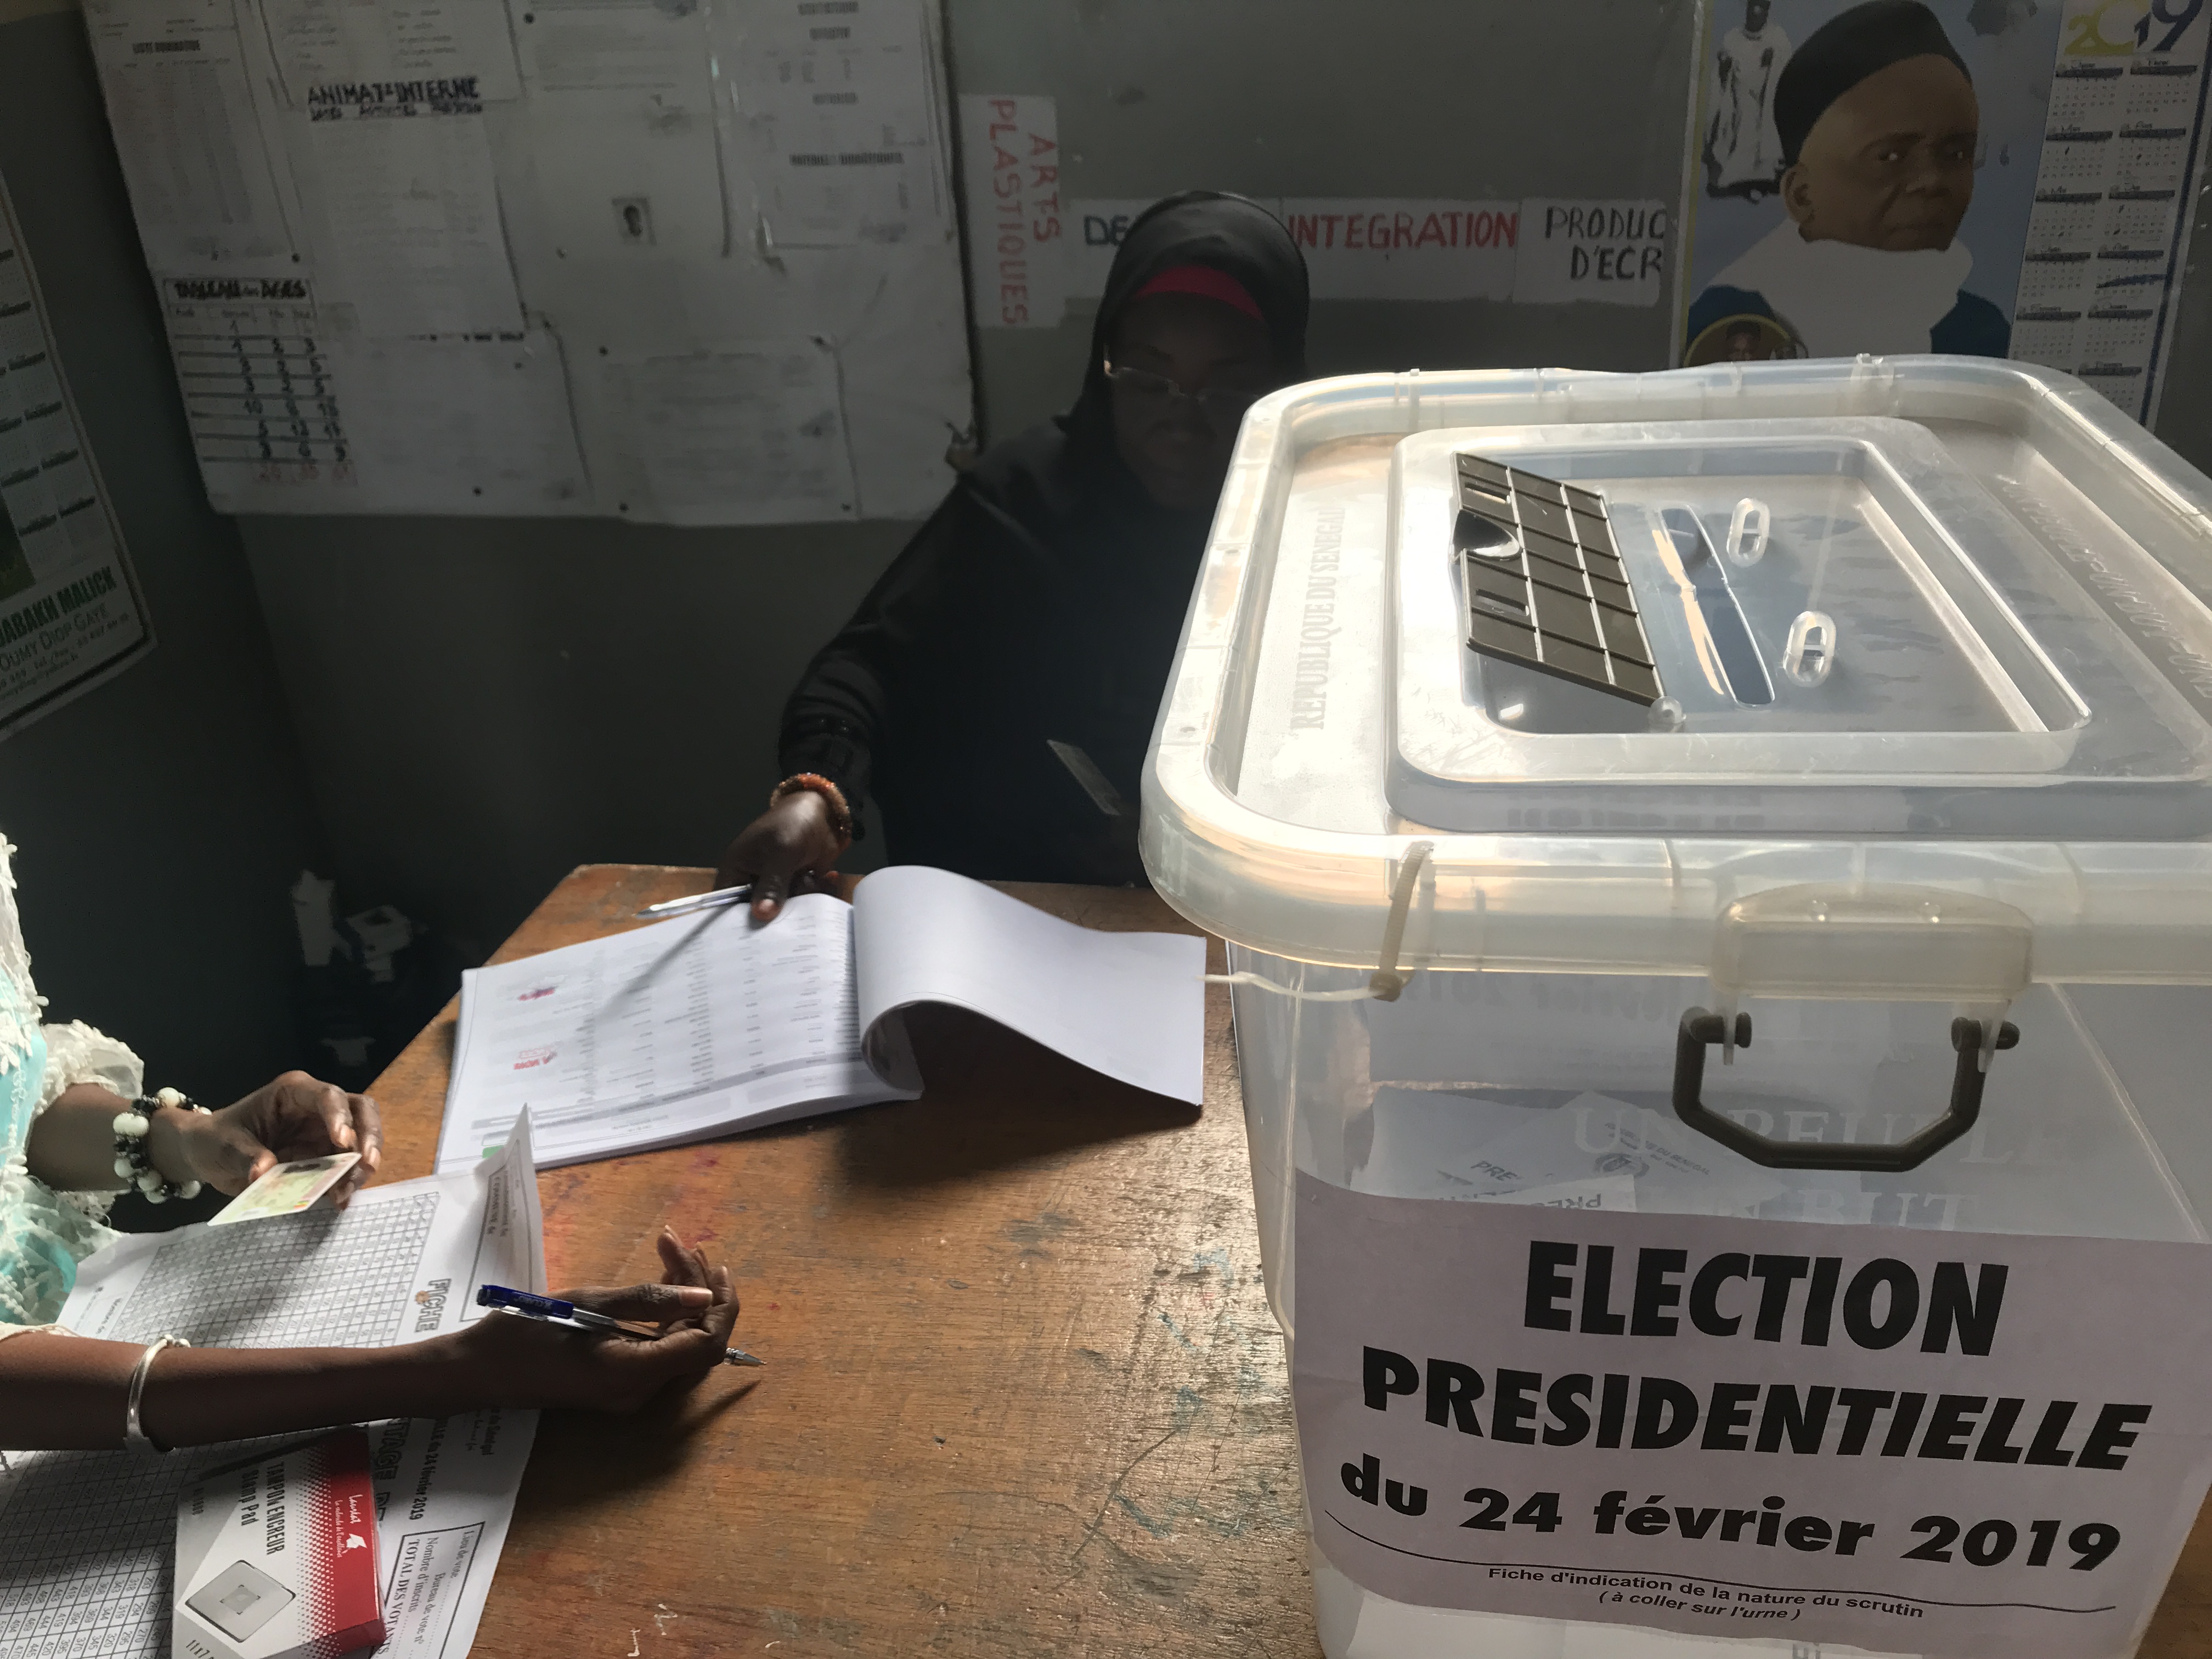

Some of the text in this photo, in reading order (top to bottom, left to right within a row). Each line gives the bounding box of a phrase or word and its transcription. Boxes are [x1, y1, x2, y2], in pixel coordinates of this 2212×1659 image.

[2064, 0, 2203, 56] 2019
[1029, 132, 1063, 244] ARTS
[986, 99, 1030, 325] PLASTIQUES
[1289, 210, 1518, 249] INTEGRATION
[1570, 245, 1663, 281] D'ECR
[1290, 507, 1346, 730] REPUBLIQUE DU SENEGAL
[414, 1278, 453, 1333] FICHE
[1523, 1239, 2009, 1357] ELECTION
[1361, 1345, 2152, 1471] PRESIDENTIELLE
[240, 1503, 259, 1527] Pad
[266, 1461, 285, 1556] TAMPON ENCREUR
[409, 1497, 427, 1521] 2019
[1341, 1453, 2121, 1573] du 24 février 2019
[420, 1537, 439, 1573] Nombre
[456, 1550, 467, 1561] de
[450, 1562, 462, 1579] vote
[111, 1581, 125, 1593] 343
[126, 1578, 139, 1591] 318
[428, 1572, 447, 1604] Bureau
[21, 1593, 32, 1606] 493
[51, 1589, 63, 1601] 443
[65, 1587, 78, 1599] 418
[377, 1538, 421, 1655] TOTAL DES VOTANTS
[1488, 1567, 1925, 1618] Fiche d'indication de la nature du scrutin
[5, 1594, 19, 1607] 518
[1629, 1592, 1688, 1611] coller
[1691, 1600, 1726, 1616] sur
[1731, 1605, 1788, 1621] l'urne
[70, 1611, 82, 1625] 394
[84, 1609, 98, 1623] 369
[100, 1606, 112, 1620] 344
[115, 1605, 128, 1618] 319
[119, 1576, 155, 1645] 293 294 295
[8, 1620, 20, 1633] 494
[24, 1618, 36, 1631] 469
[38, 1616, 51, 1629] 444
[54, 1613, 66, 1627] 419
[417, 1615, 430, 1634] vote
[88, 1635, 101, 1650] 345
[104, 1633, 117, 1647] 320
[135, 1629, 148, 1643] 270
[26, 1644, 39, 1657] 445
[42, 1641, 54, 1656] 420
[58, 1639, 70, 1654] 395
[73, 1637, 86, 1652] 370
